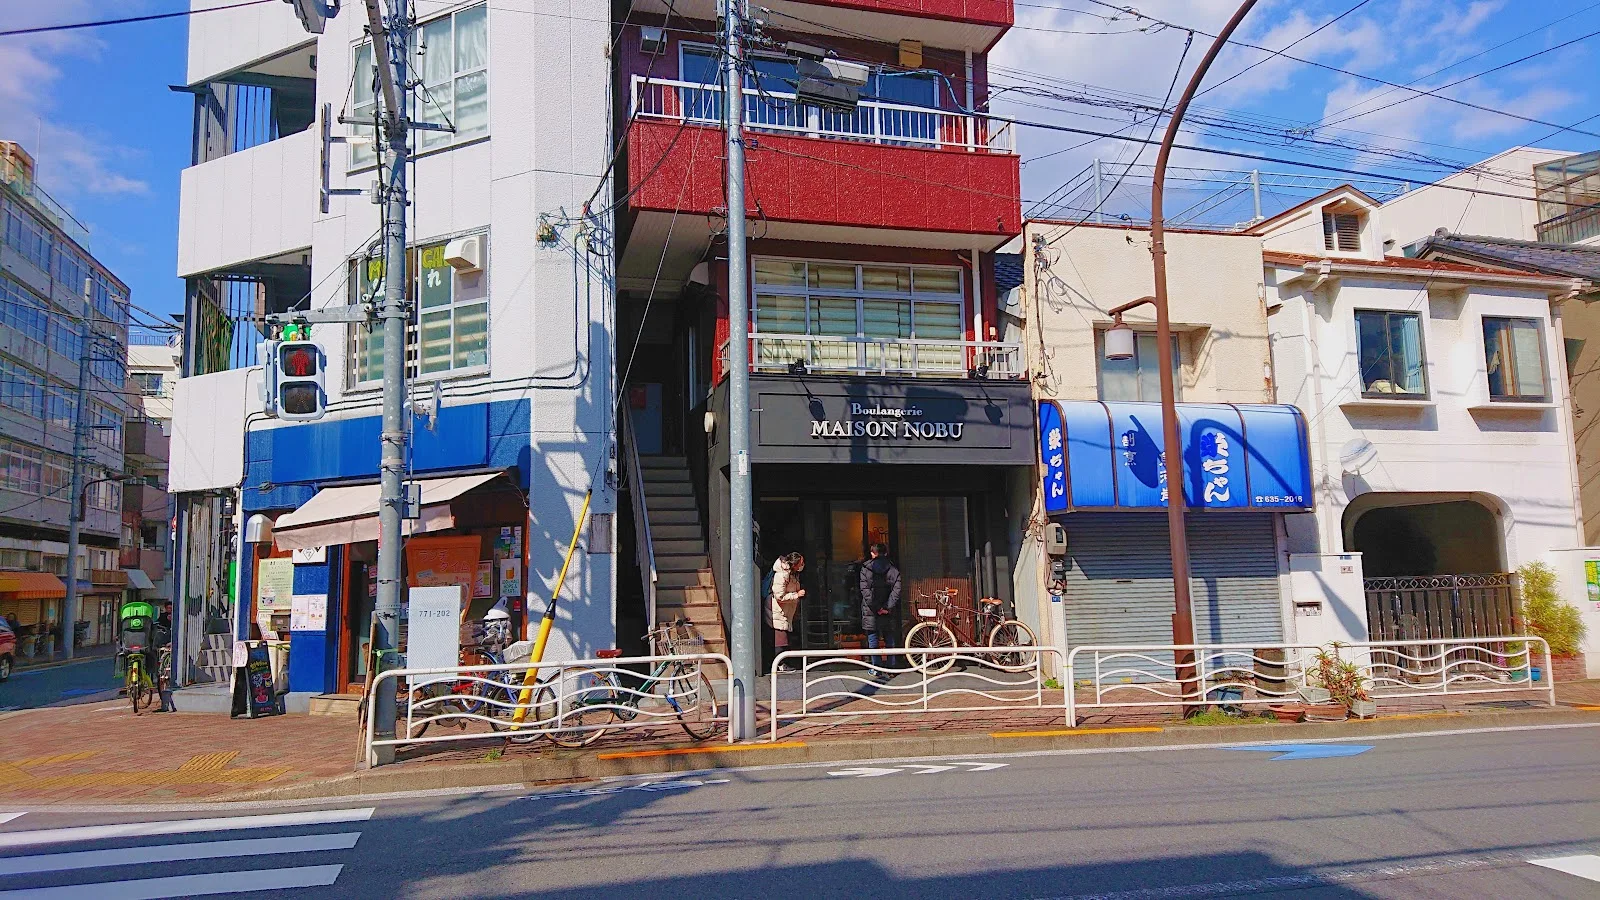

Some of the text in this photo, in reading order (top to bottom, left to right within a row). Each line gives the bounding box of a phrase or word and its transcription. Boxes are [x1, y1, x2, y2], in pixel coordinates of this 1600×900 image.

[851, 402, 923, 418] Boulangerie
[810, 421, 964, 439] MAISON NOBU
[418, 550, 448, 562] ランチ
[439, 561, 471, 572] タイム
[418, 609, 451, 618] 771-202
